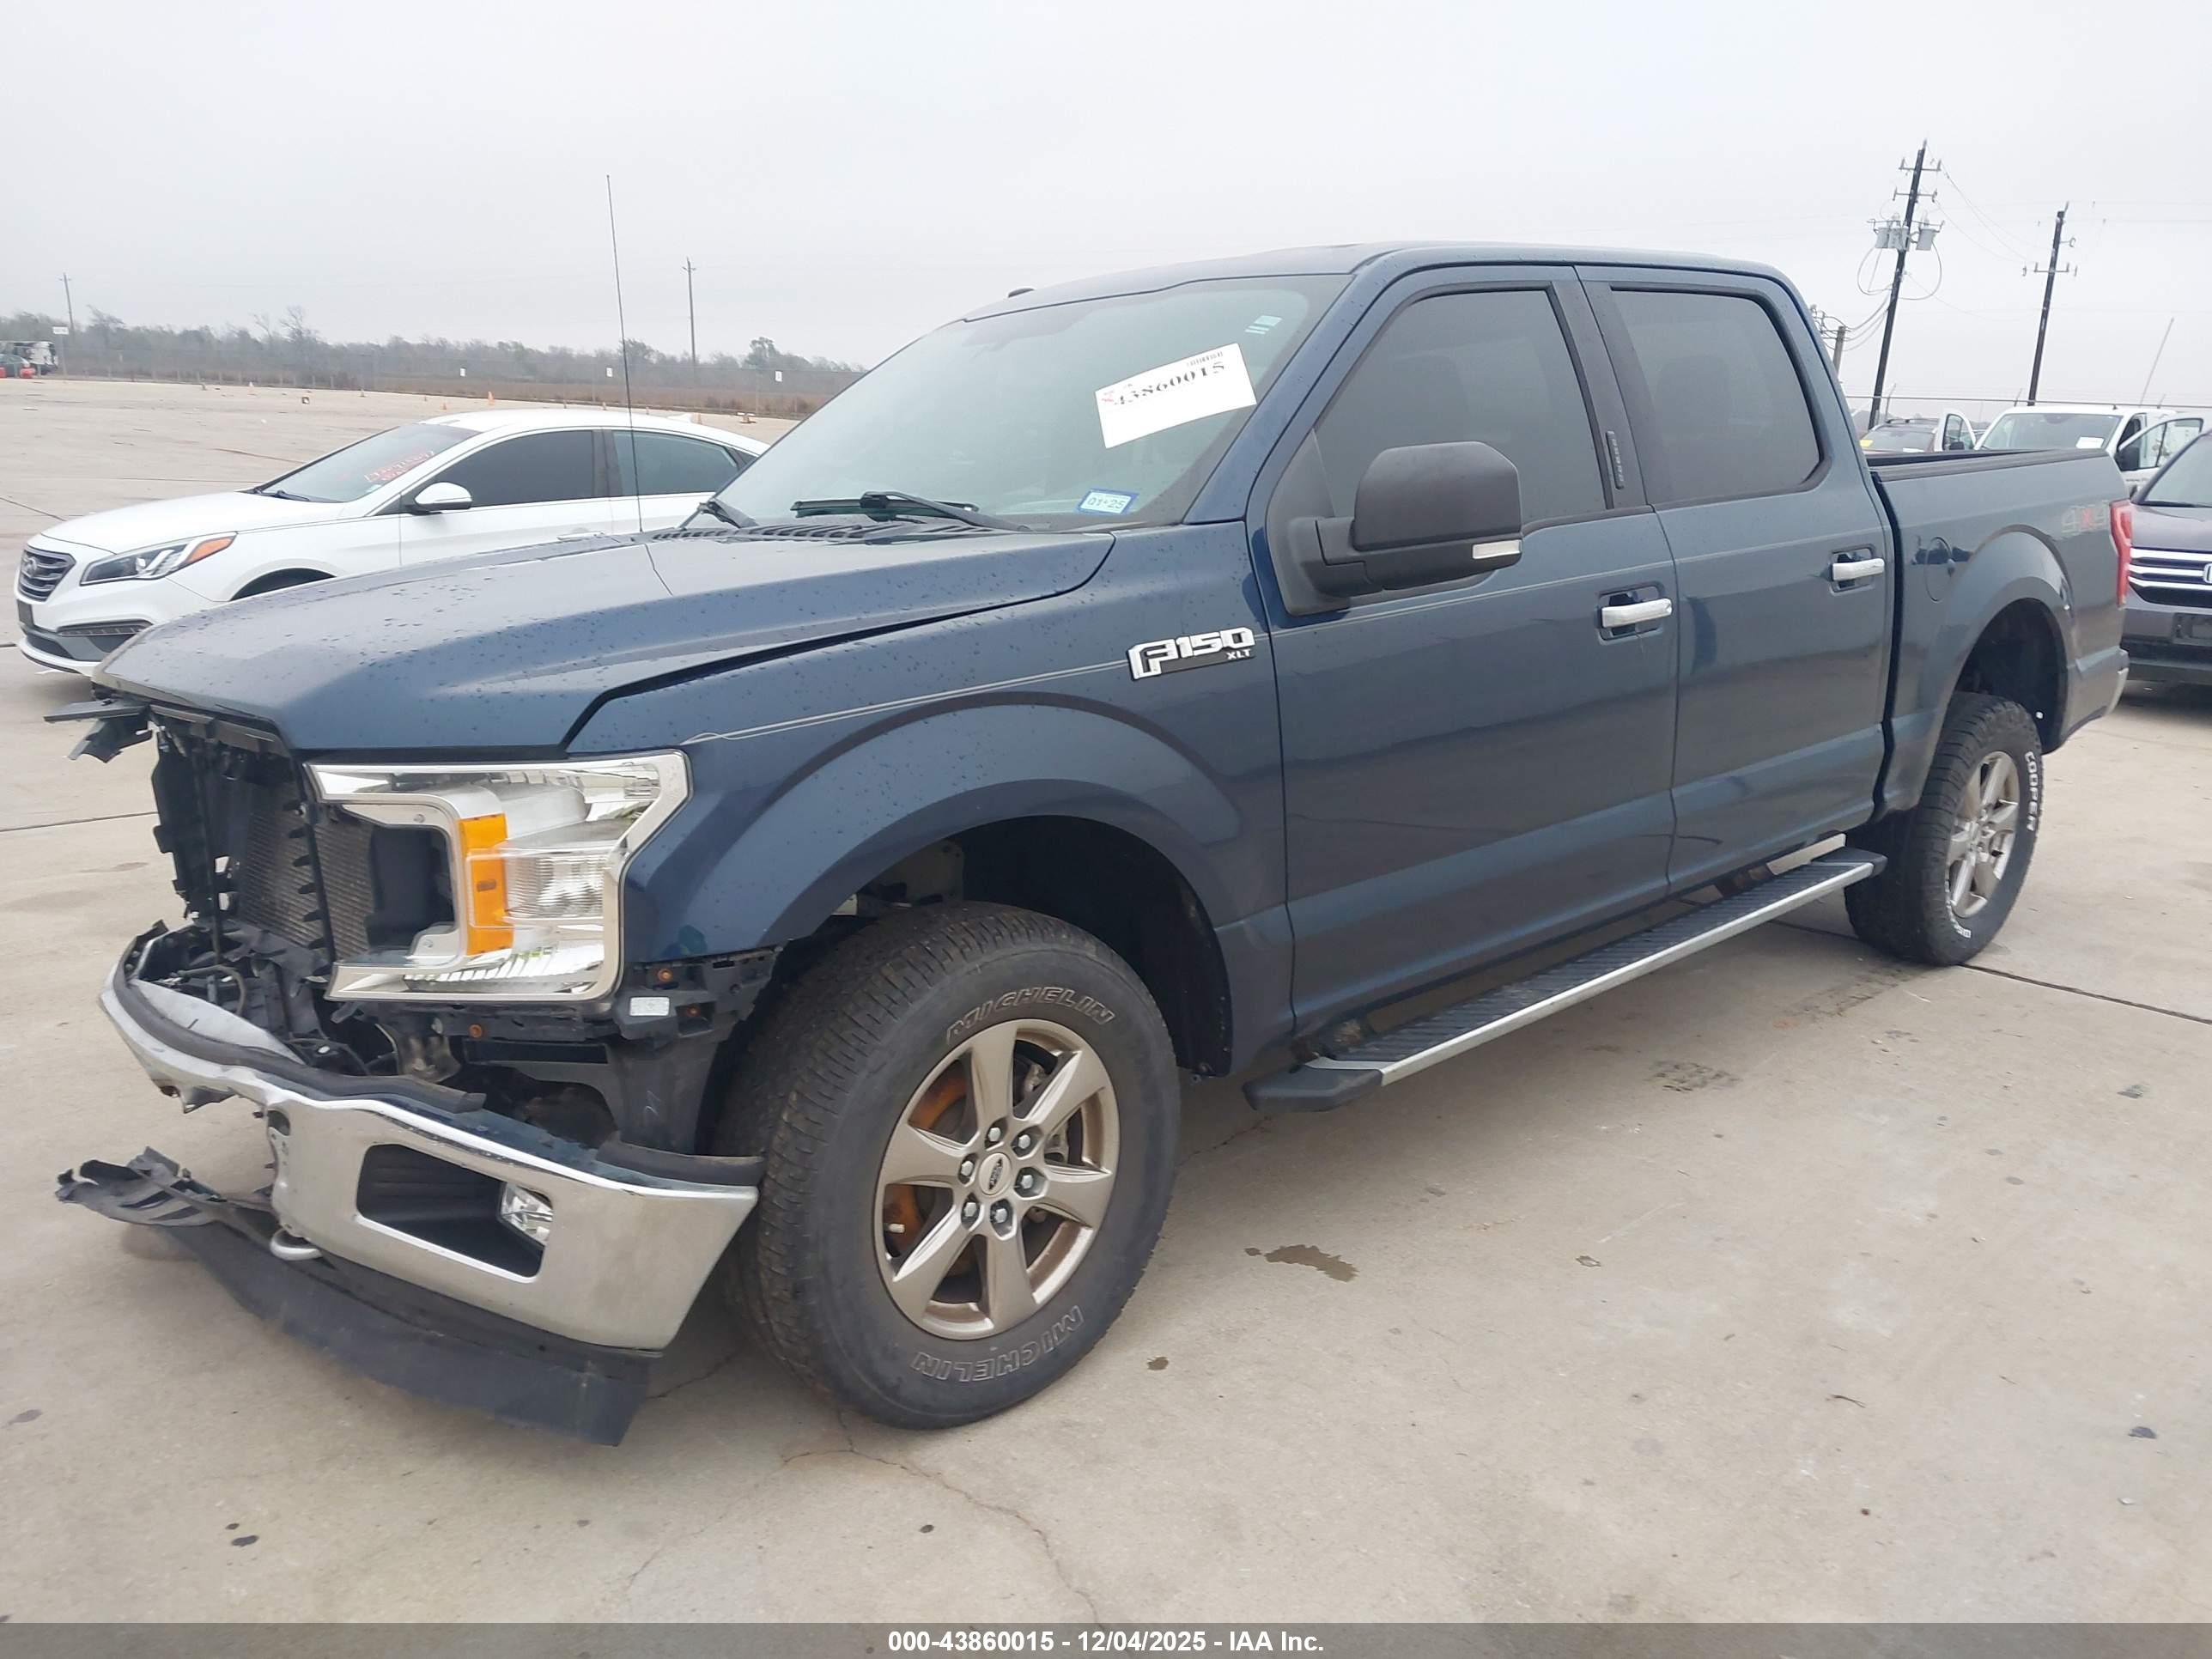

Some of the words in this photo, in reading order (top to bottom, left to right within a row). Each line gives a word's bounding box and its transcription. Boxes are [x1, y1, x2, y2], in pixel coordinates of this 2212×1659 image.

[1225, 648, 1252, 660] XLT
[946, 986, 1116, 1045] MICHELIN
[910, 1304, 1085, 1382] MICHELIN
